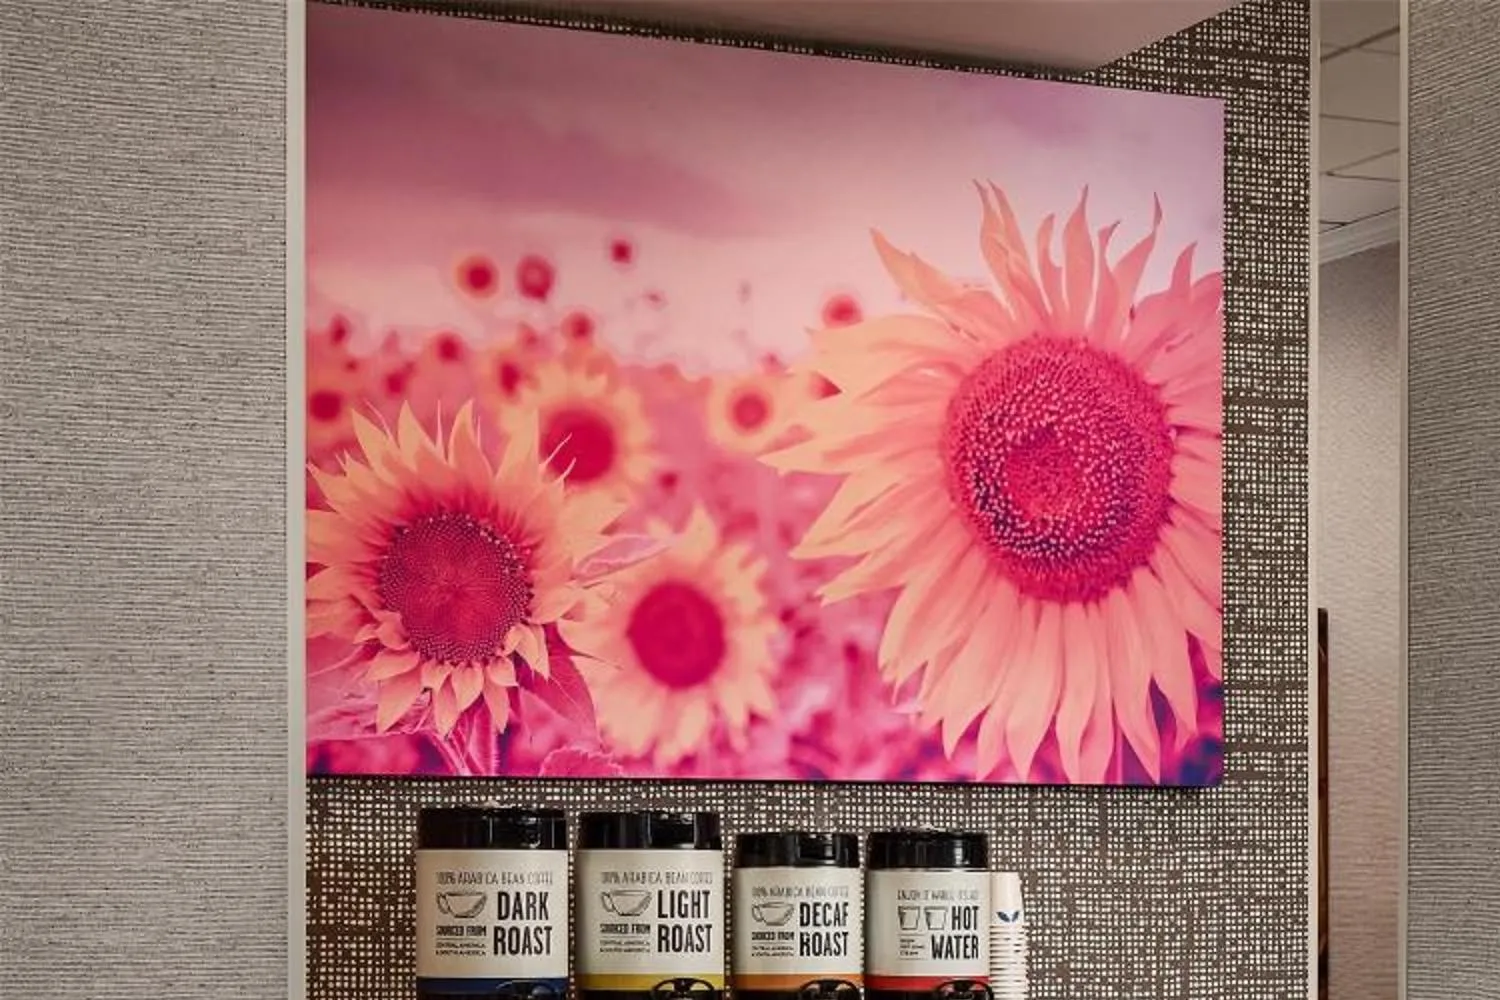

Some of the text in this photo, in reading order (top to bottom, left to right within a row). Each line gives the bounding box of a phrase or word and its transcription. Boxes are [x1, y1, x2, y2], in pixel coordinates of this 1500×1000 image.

[497, 891, 549, 920] DARK
[657, 890, 711, 919] LIGHT
[800, 902, 849, 927] DECAF
[951, 906, 979, 930] HOT
[493, 926, 553, 955] ROAST
[657, 924, 713, 952] ROAST
[800, 932, 849, 957] ROAST
[931, 934, 979, 960] WATER
